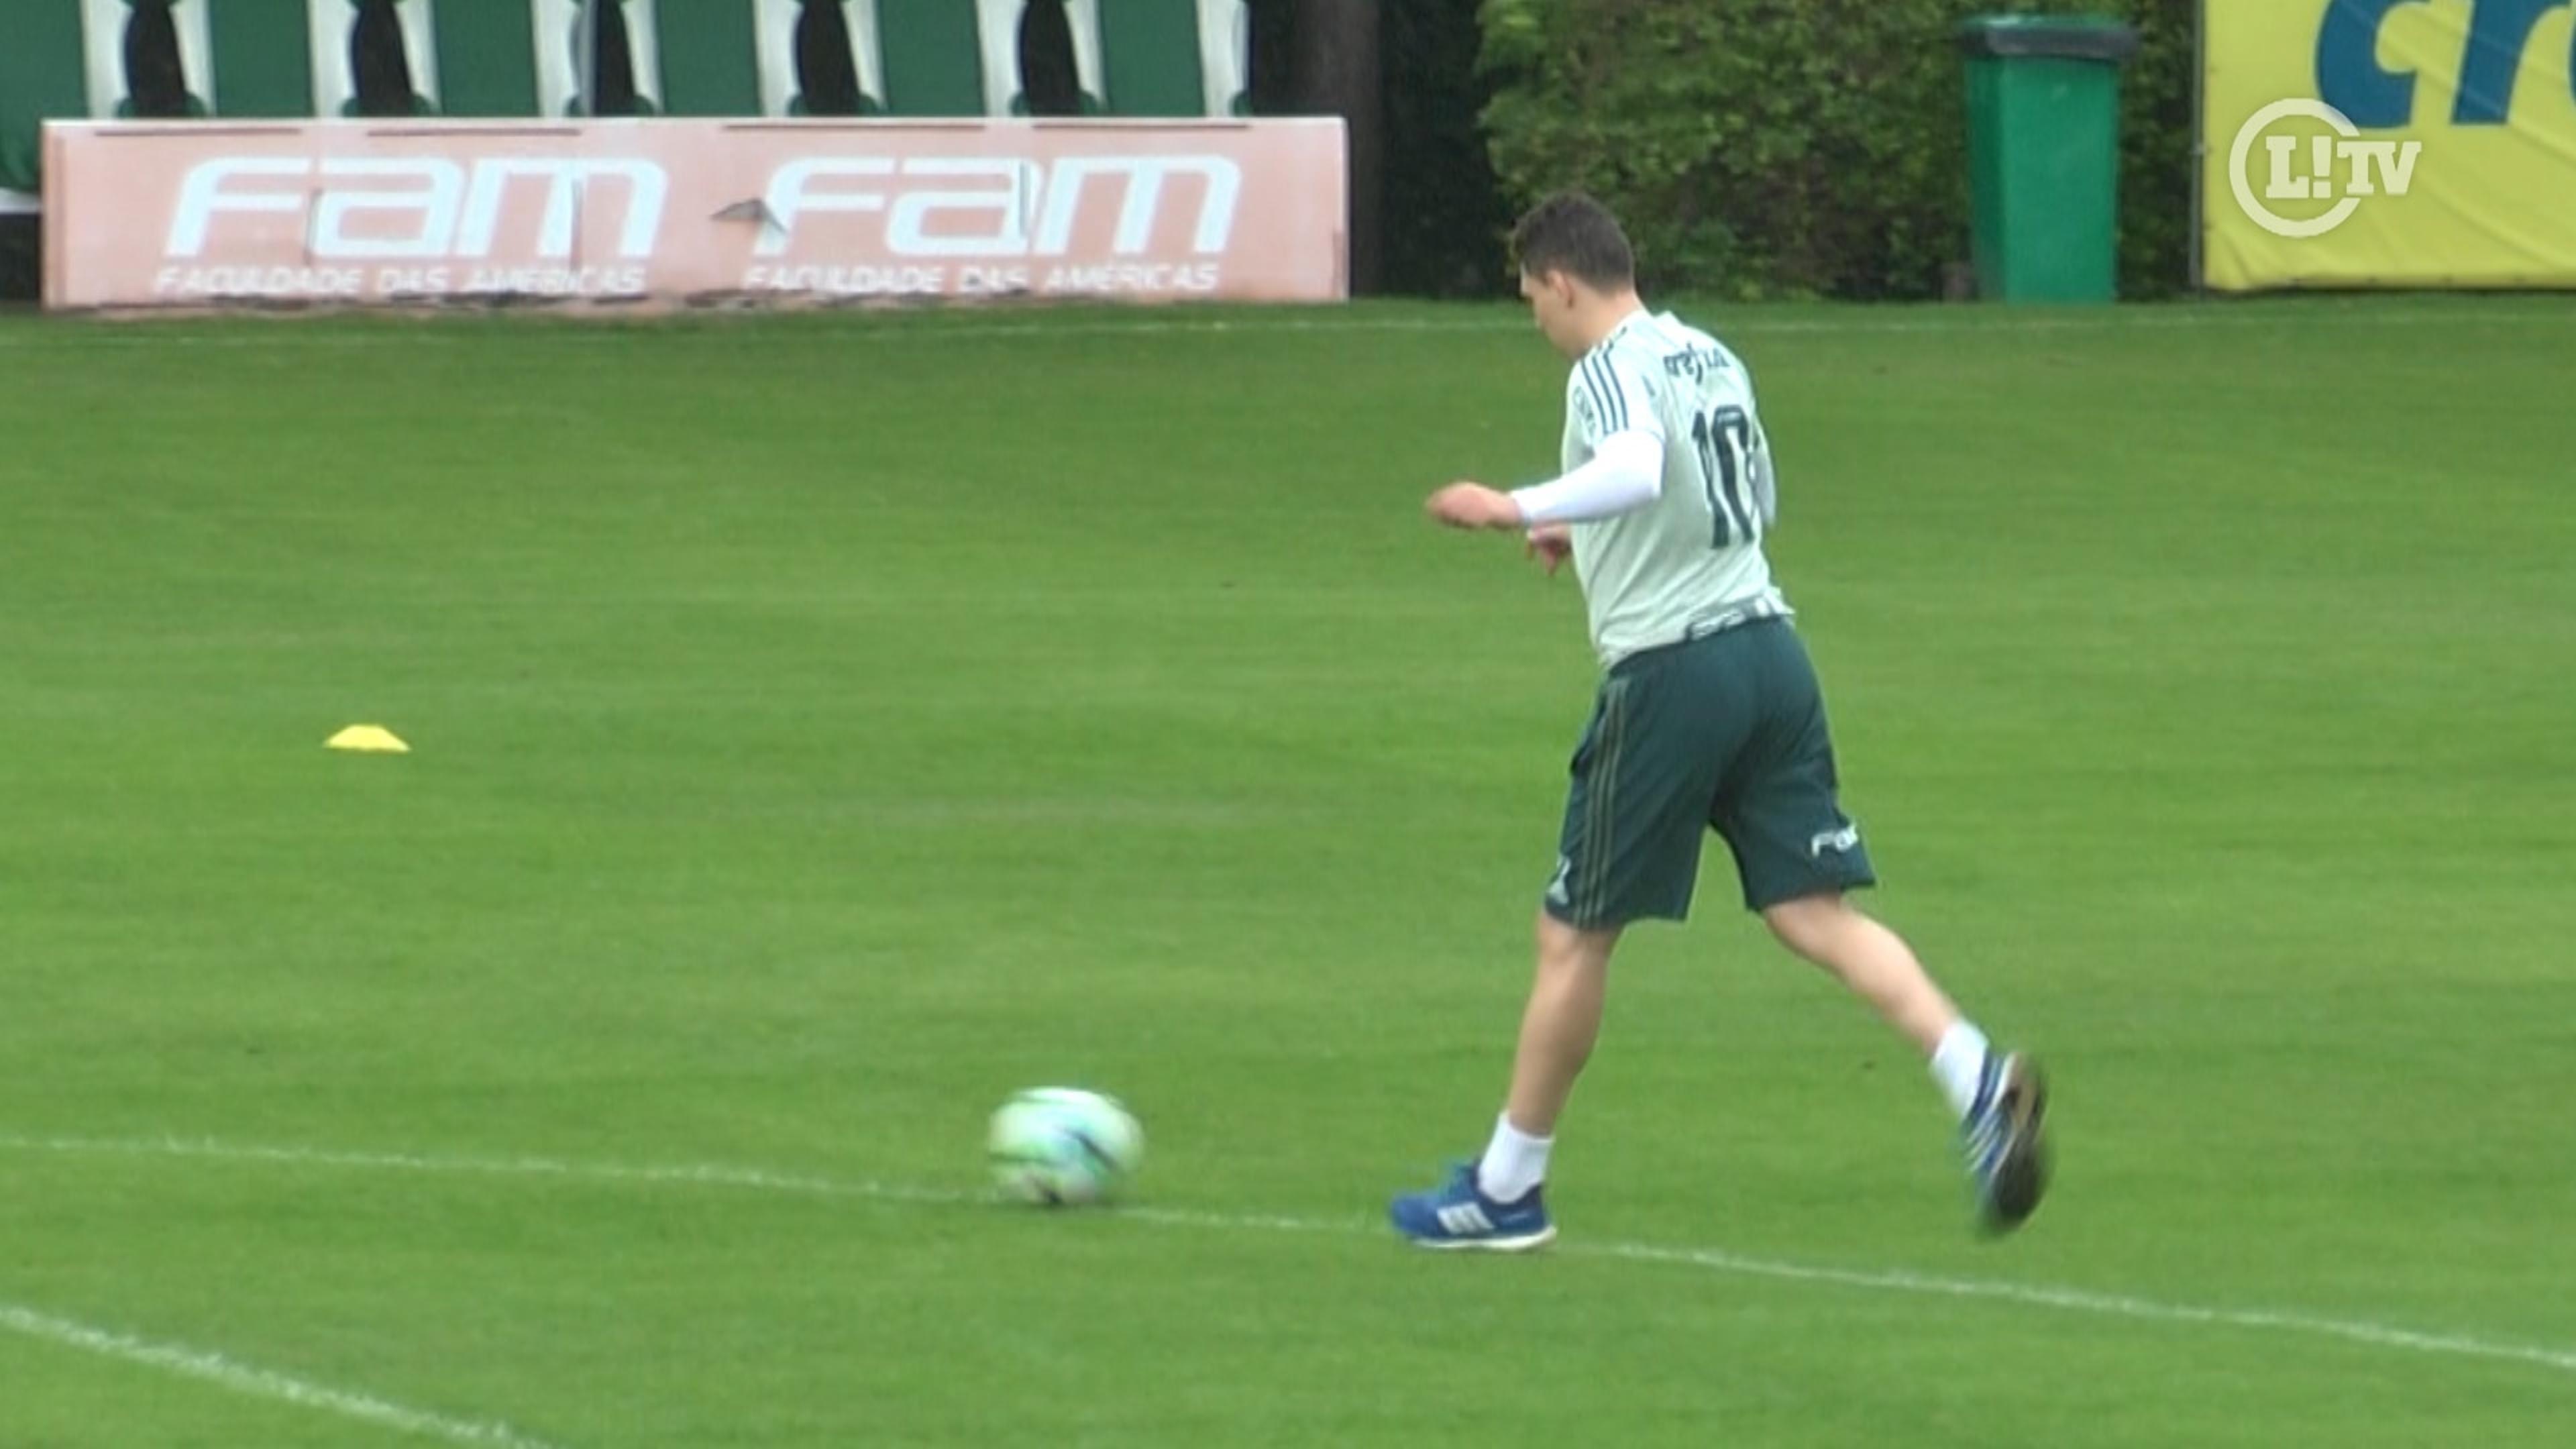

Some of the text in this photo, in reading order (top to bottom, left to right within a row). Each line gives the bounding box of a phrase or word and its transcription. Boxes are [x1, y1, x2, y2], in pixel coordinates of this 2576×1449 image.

[2317, 0, 2576, 127] cr
[155, 266, 362, 294] FACULDADE
[378, 266, 449, 292] DAS
[743, 266, 944, 292] FACULDADE
[960, 266, 1027, 291] DAS
[1692, 405, 1756, 549] 10
